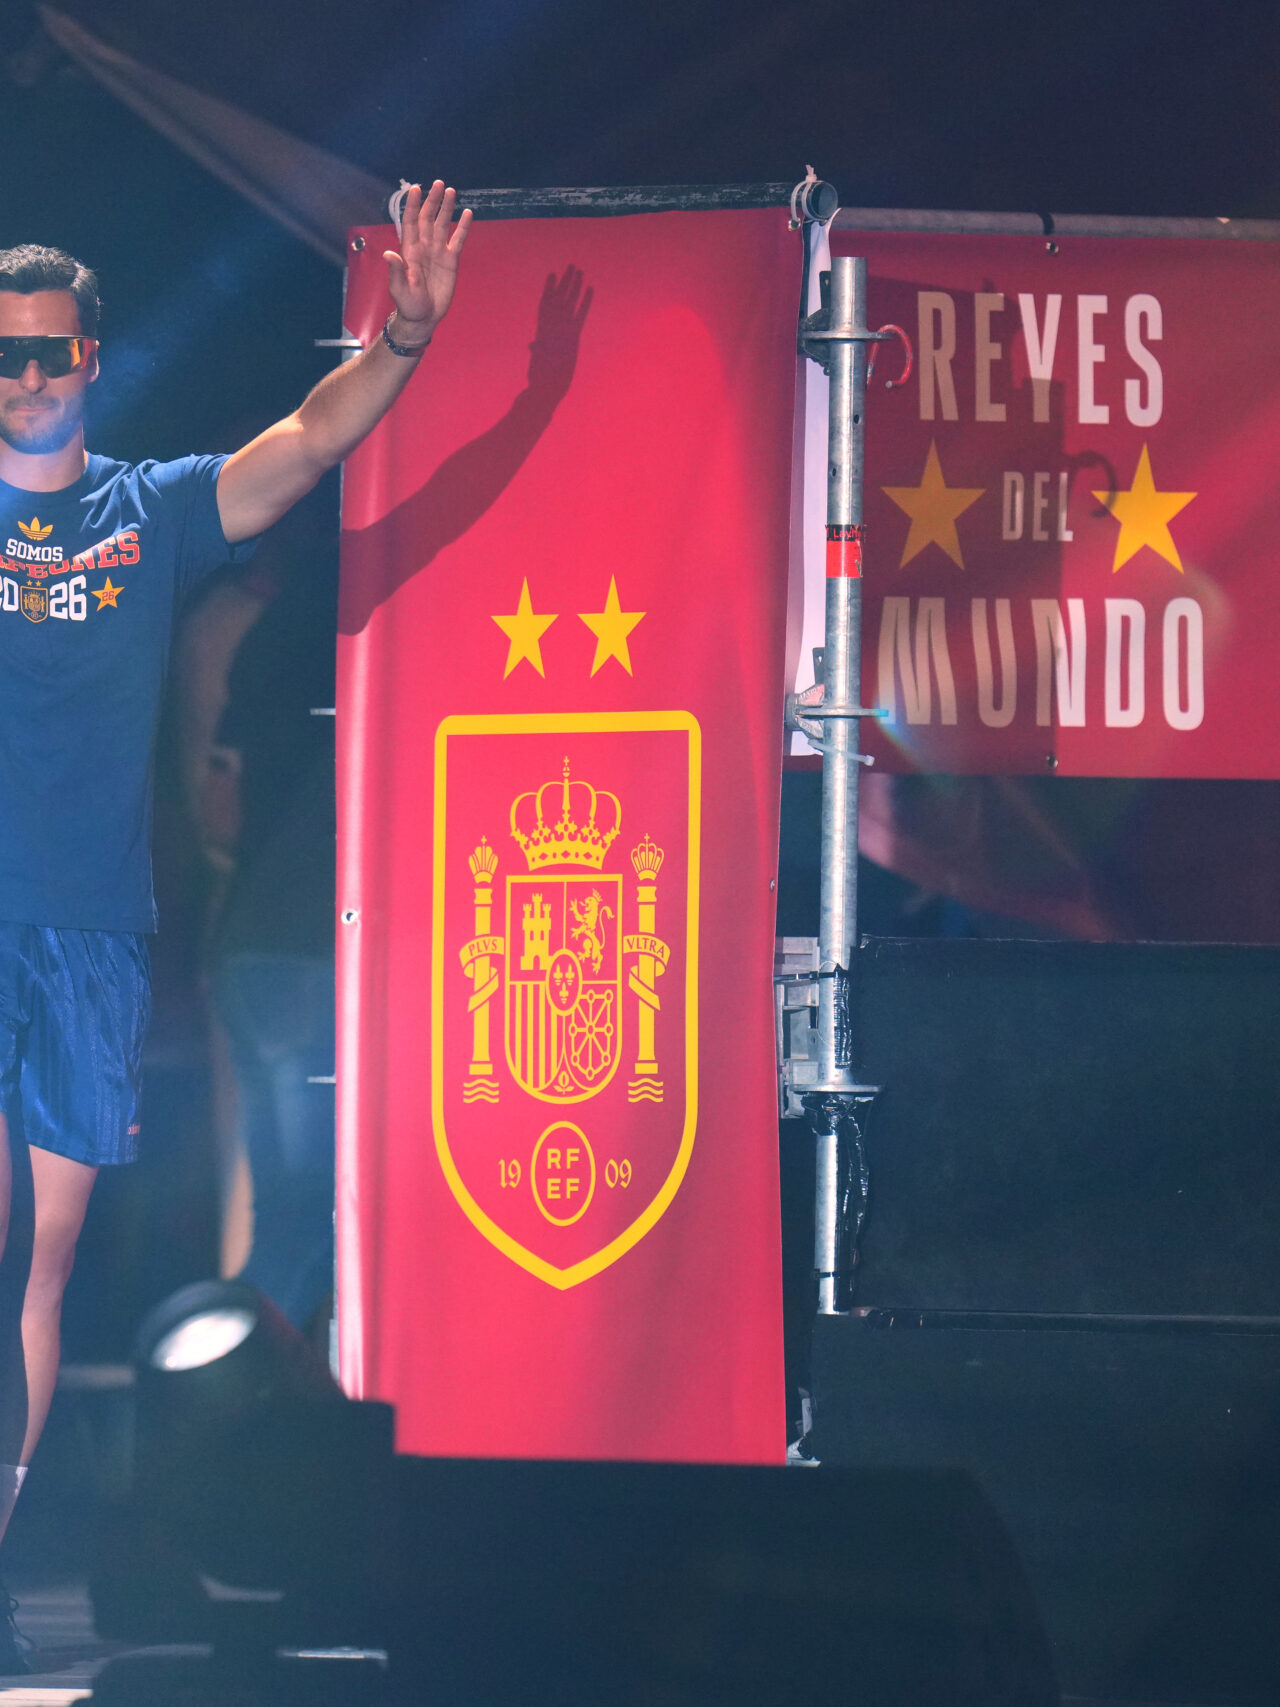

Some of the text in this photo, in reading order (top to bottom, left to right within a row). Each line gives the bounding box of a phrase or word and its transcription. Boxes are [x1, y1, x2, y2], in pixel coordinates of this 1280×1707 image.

[917, 291, 1164, 427] REYES
[1001, 471, 1074, 542] DEL
[5, 538, 64, 562] SOMOS
[49, 574, 87, 621] 26
[101, 590, 115, 602] 26
[877, 596, 1205, 731] MUNDO
[468, 938, 498, 957] PLVS
[626, 937, 665, 959] VLTRA
[547, 1148, 580, 1170] RF
[498, 1158, 522, 1189] 19
[604, 1158, 632, 1189] 09
[547, 1178, 580, 1199] EF
